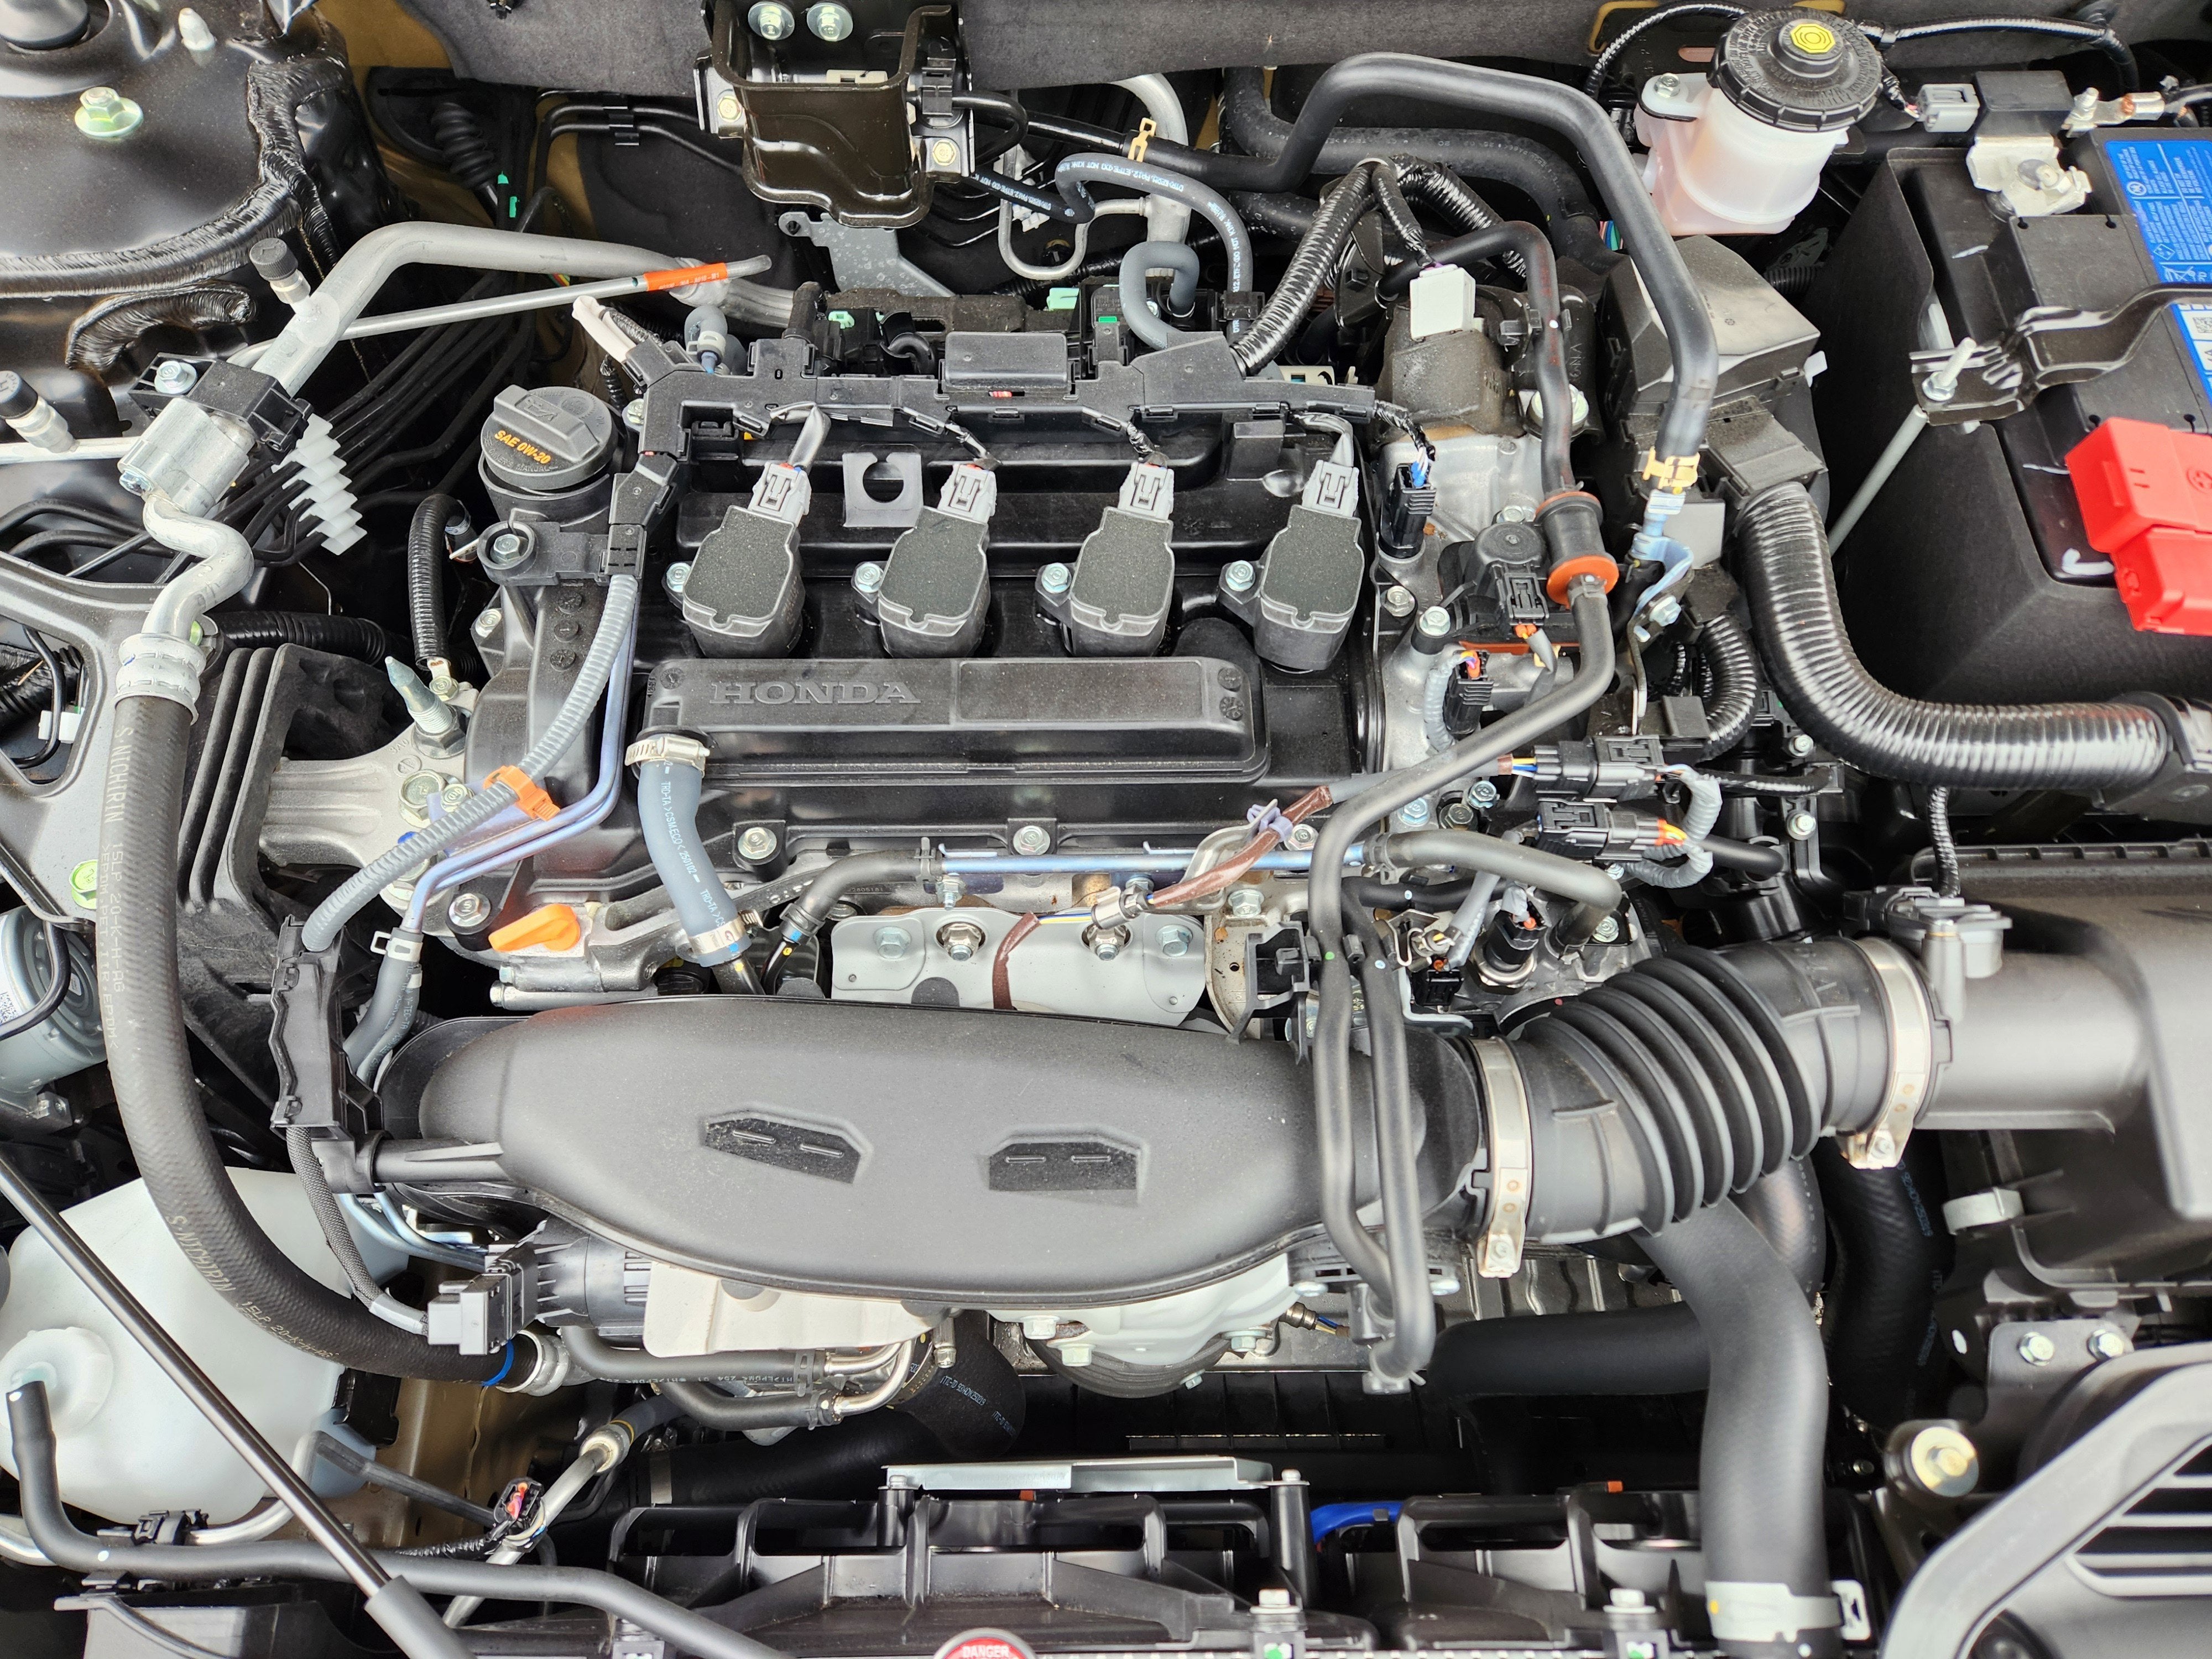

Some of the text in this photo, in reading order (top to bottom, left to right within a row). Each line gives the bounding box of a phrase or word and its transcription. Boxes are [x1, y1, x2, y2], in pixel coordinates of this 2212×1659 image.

[494, 430, 551, 465] SAE 0W-20
[709, 682, 921, 704] HONDA
[679, 851, 697, 875] 250102
[962, 1645, 1009, 1658] DANGER
